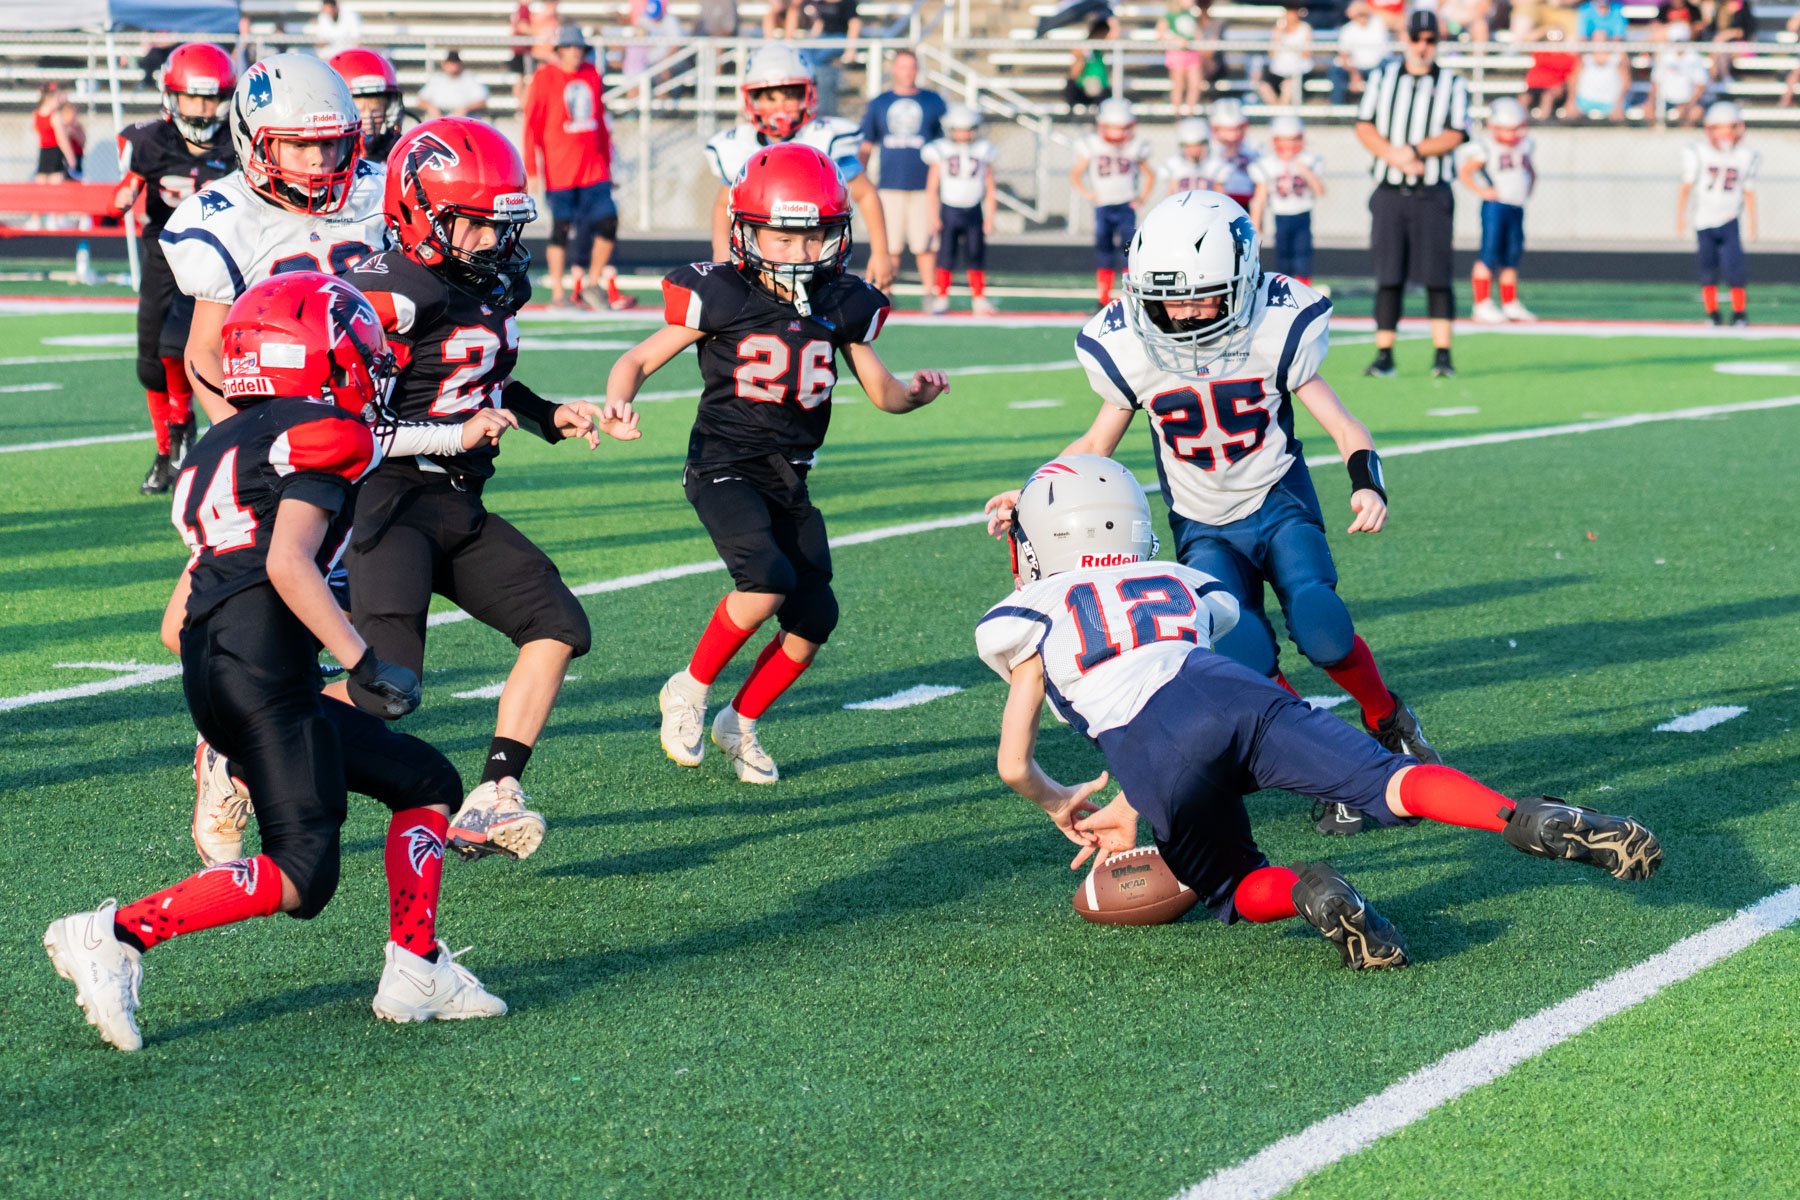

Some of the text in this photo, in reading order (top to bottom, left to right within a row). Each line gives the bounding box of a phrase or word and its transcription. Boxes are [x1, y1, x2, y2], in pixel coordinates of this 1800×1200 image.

[312, 113, 338, 122] Riddell
[1708, 166, 1738, 191] 72
[505, 197, 525, 206] Riddell
[781, 204, 809, 213] Riddell
[733, 333, 836, 411] 26
[222, 377, 269, 395] Riddell
[1150, 377, 1271, 473] 25
[1081, 554, 1139, 569] Riddell
[1064, 574, 1199, 676] 12
[1120, 878, 1147, 892] NCAA
